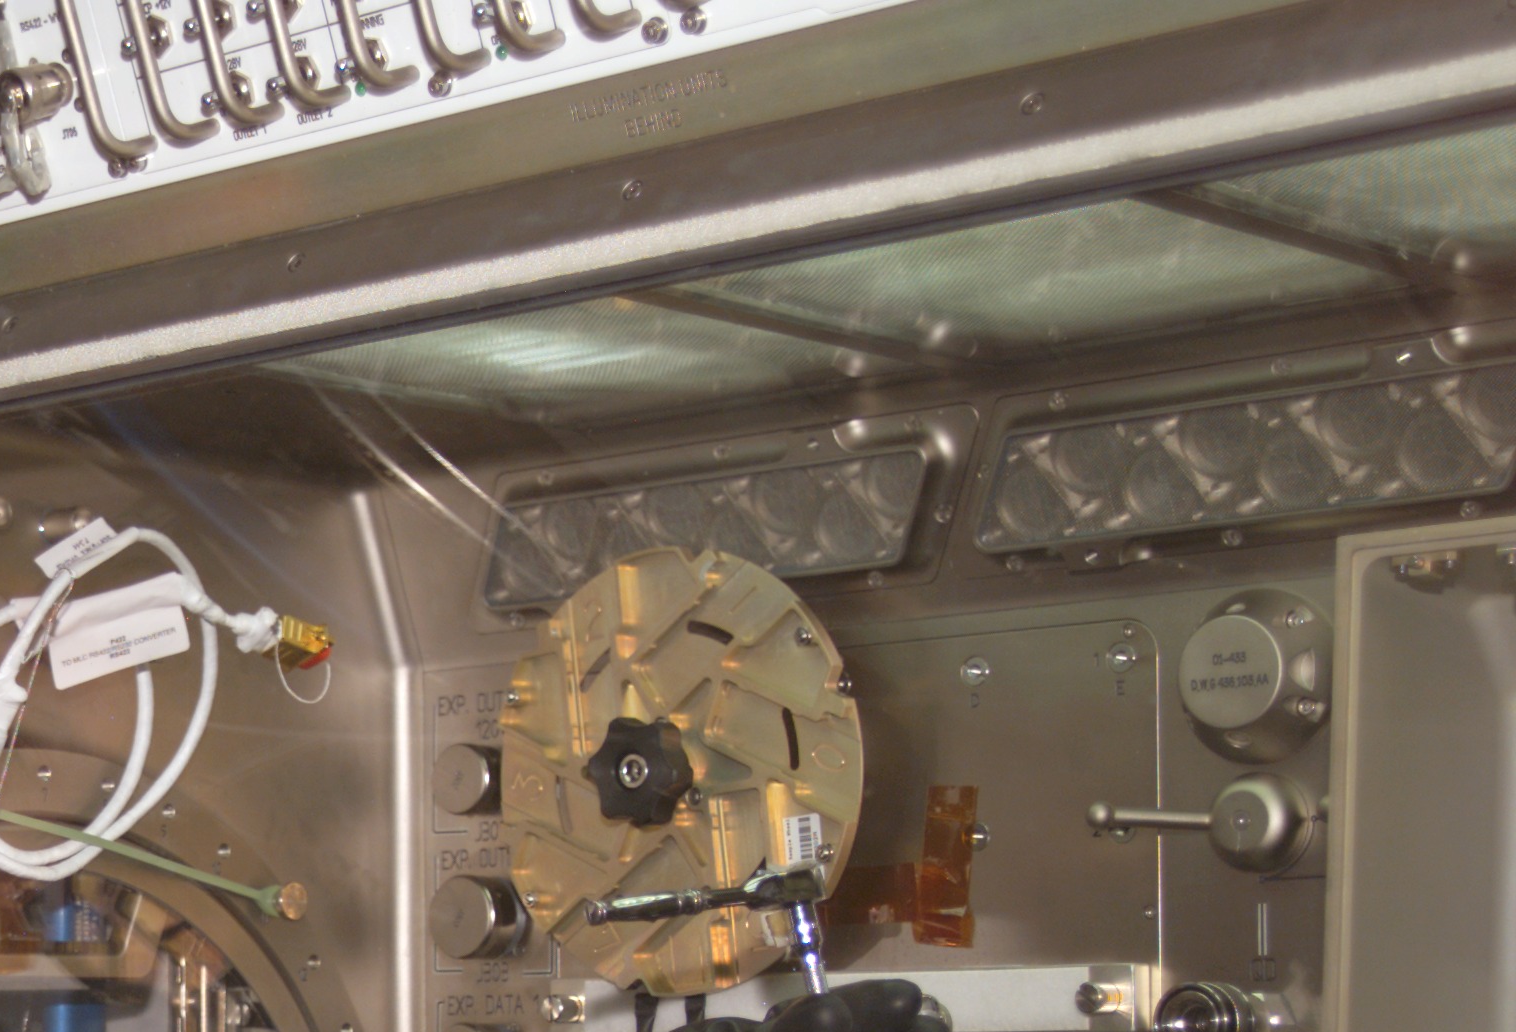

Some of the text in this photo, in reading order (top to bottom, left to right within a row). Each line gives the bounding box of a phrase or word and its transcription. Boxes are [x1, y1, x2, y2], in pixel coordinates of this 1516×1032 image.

[569, 69, 728, 124] ILLUMINATION UNITS
[297, 112, 324, 125] OUTLET
[624, 108, 683, 139] BEHIND
[134, 627, 176, 645] CONVERTER
[485, 993, 525, 1016] DATA
